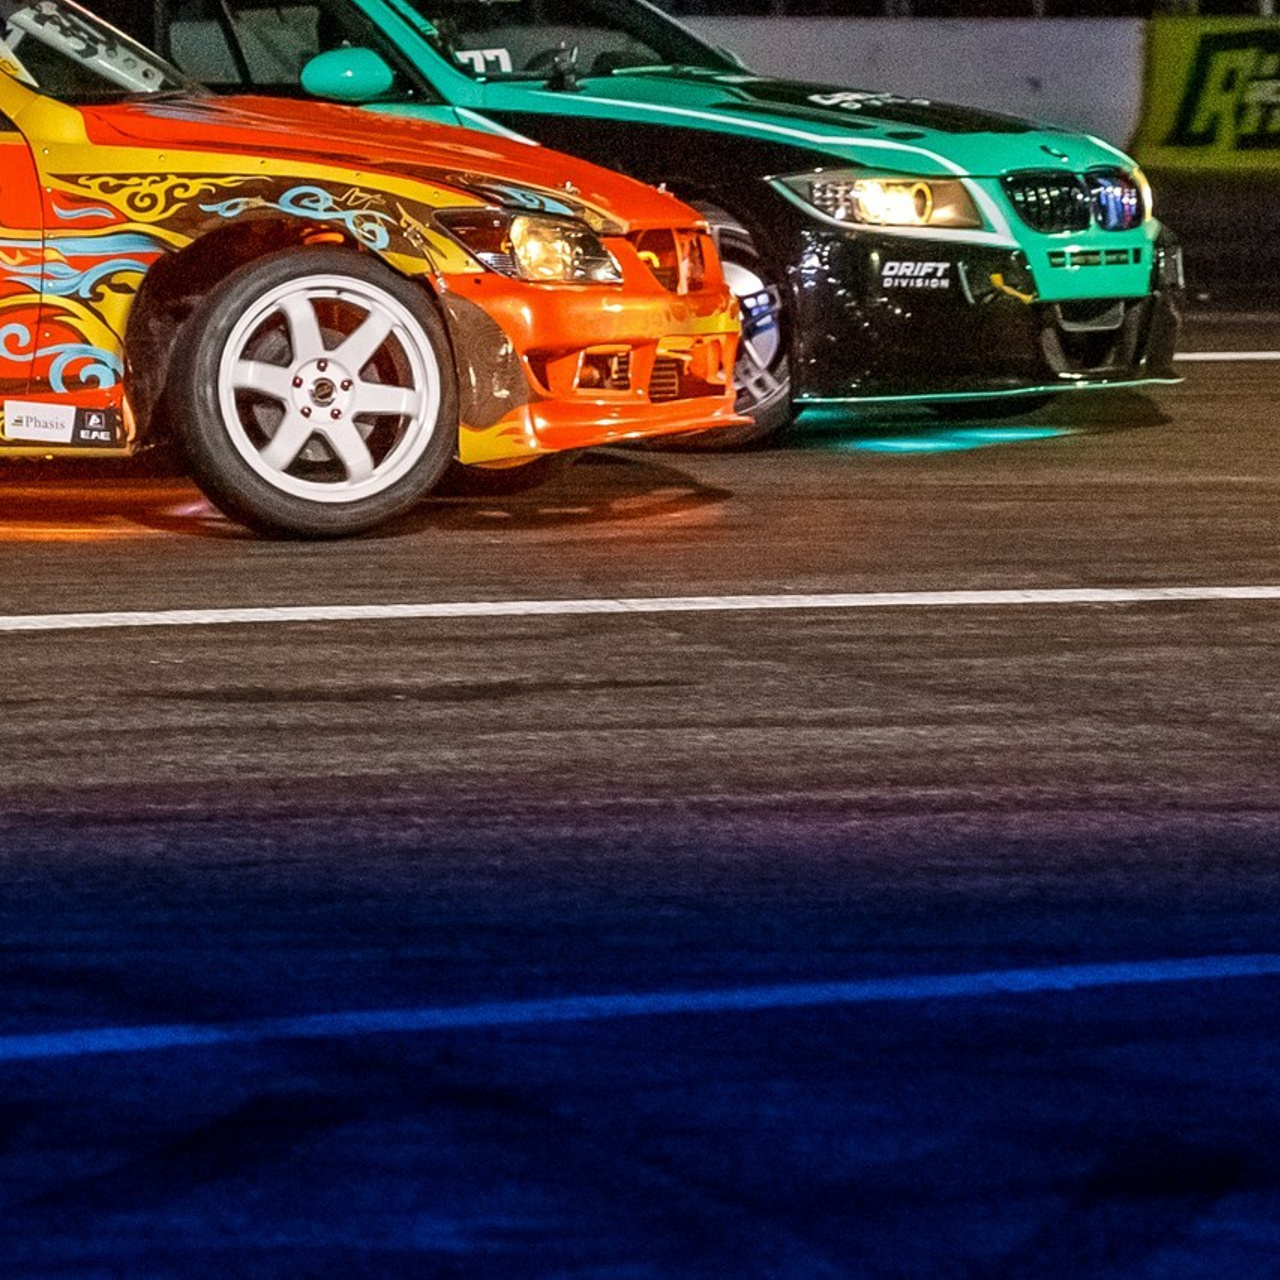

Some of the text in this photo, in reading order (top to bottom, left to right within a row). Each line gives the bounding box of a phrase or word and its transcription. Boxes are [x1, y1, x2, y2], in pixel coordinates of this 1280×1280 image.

[454, 48, 513, 73] 77
[881, 261, 951, 277] DRIFT
[883, 277, 950, 289] DIVISION
[25, 415, 66, 430] Phasis
